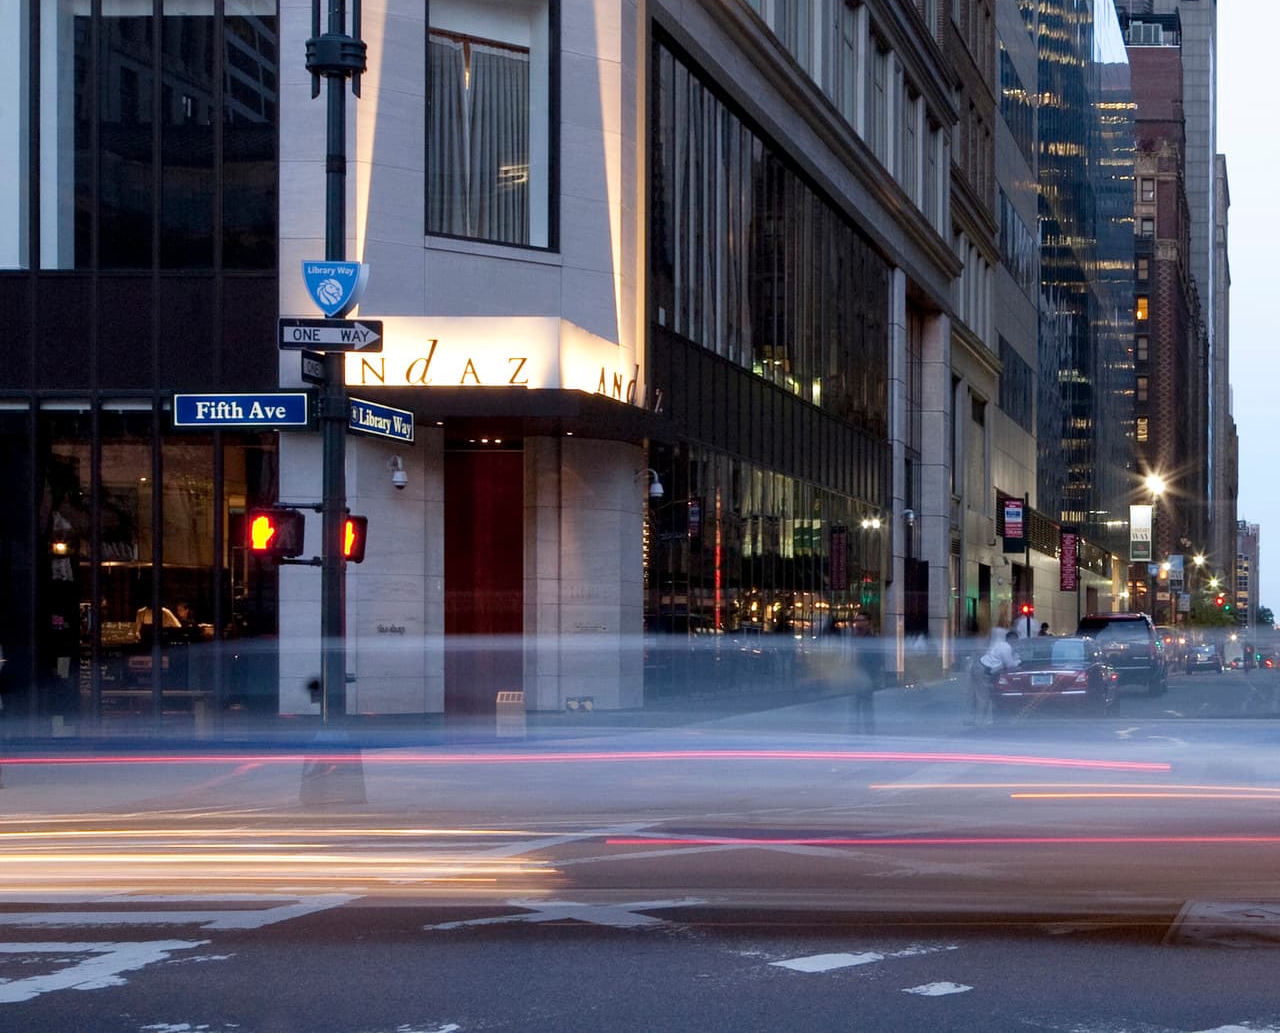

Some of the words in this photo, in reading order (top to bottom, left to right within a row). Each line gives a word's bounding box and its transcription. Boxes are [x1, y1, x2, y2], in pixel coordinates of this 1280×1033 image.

[307, 266, 335, 276] Library
[337, 267, 354, 276] Way
[293, 329, 320, 341] ONE
[341, 330, 370, 342] WAY
[361, 339, 529, 385] NdAZ
[196, 401, 243, 419] Fifth
[249, 401, 286, 418] Ave
[359, 407, 391, 433] Library
[393, 416, 412, 438] Way
